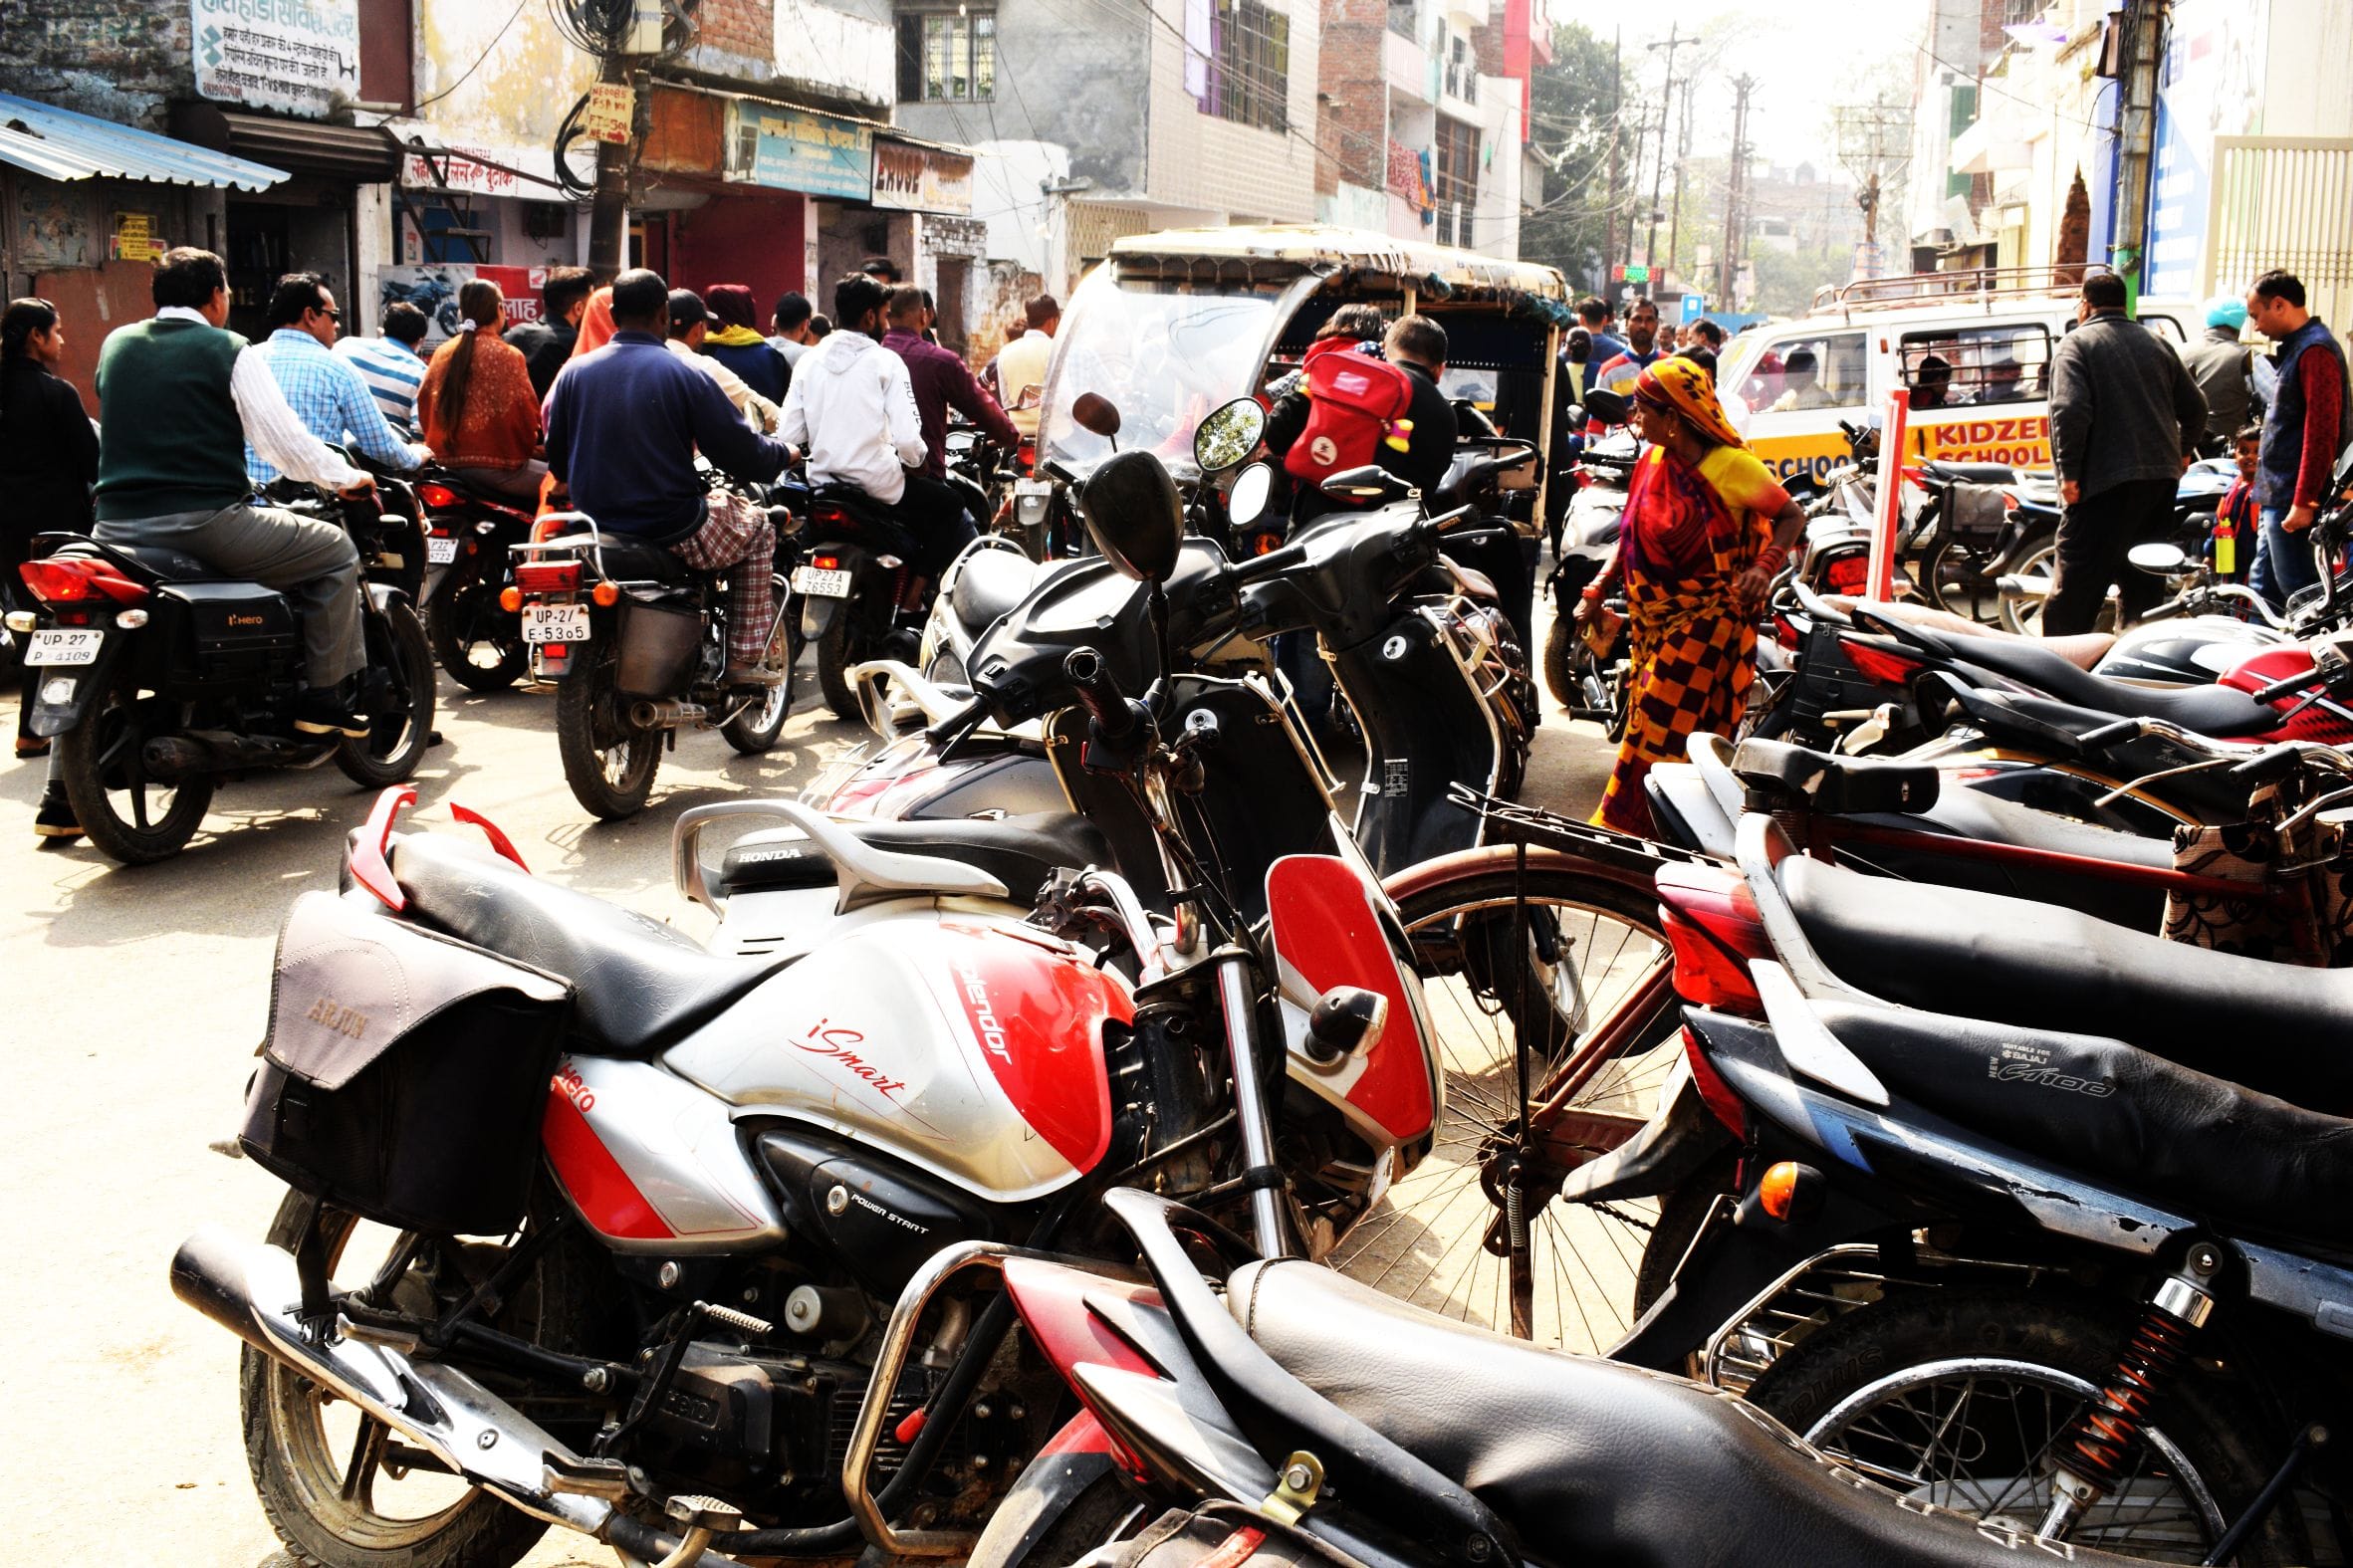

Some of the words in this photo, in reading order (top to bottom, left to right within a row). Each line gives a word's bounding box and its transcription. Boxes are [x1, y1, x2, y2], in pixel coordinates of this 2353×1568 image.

[43, 634, 63, 645] UP
[69, 634, 87, 645] 27
[738, 848, 803, 863] HONDA
[2012, 1051, 2047, 1064] BAJAJ
[851, 1193, 886, 1217] POWER
[887, 1213, 929, 1234] START
